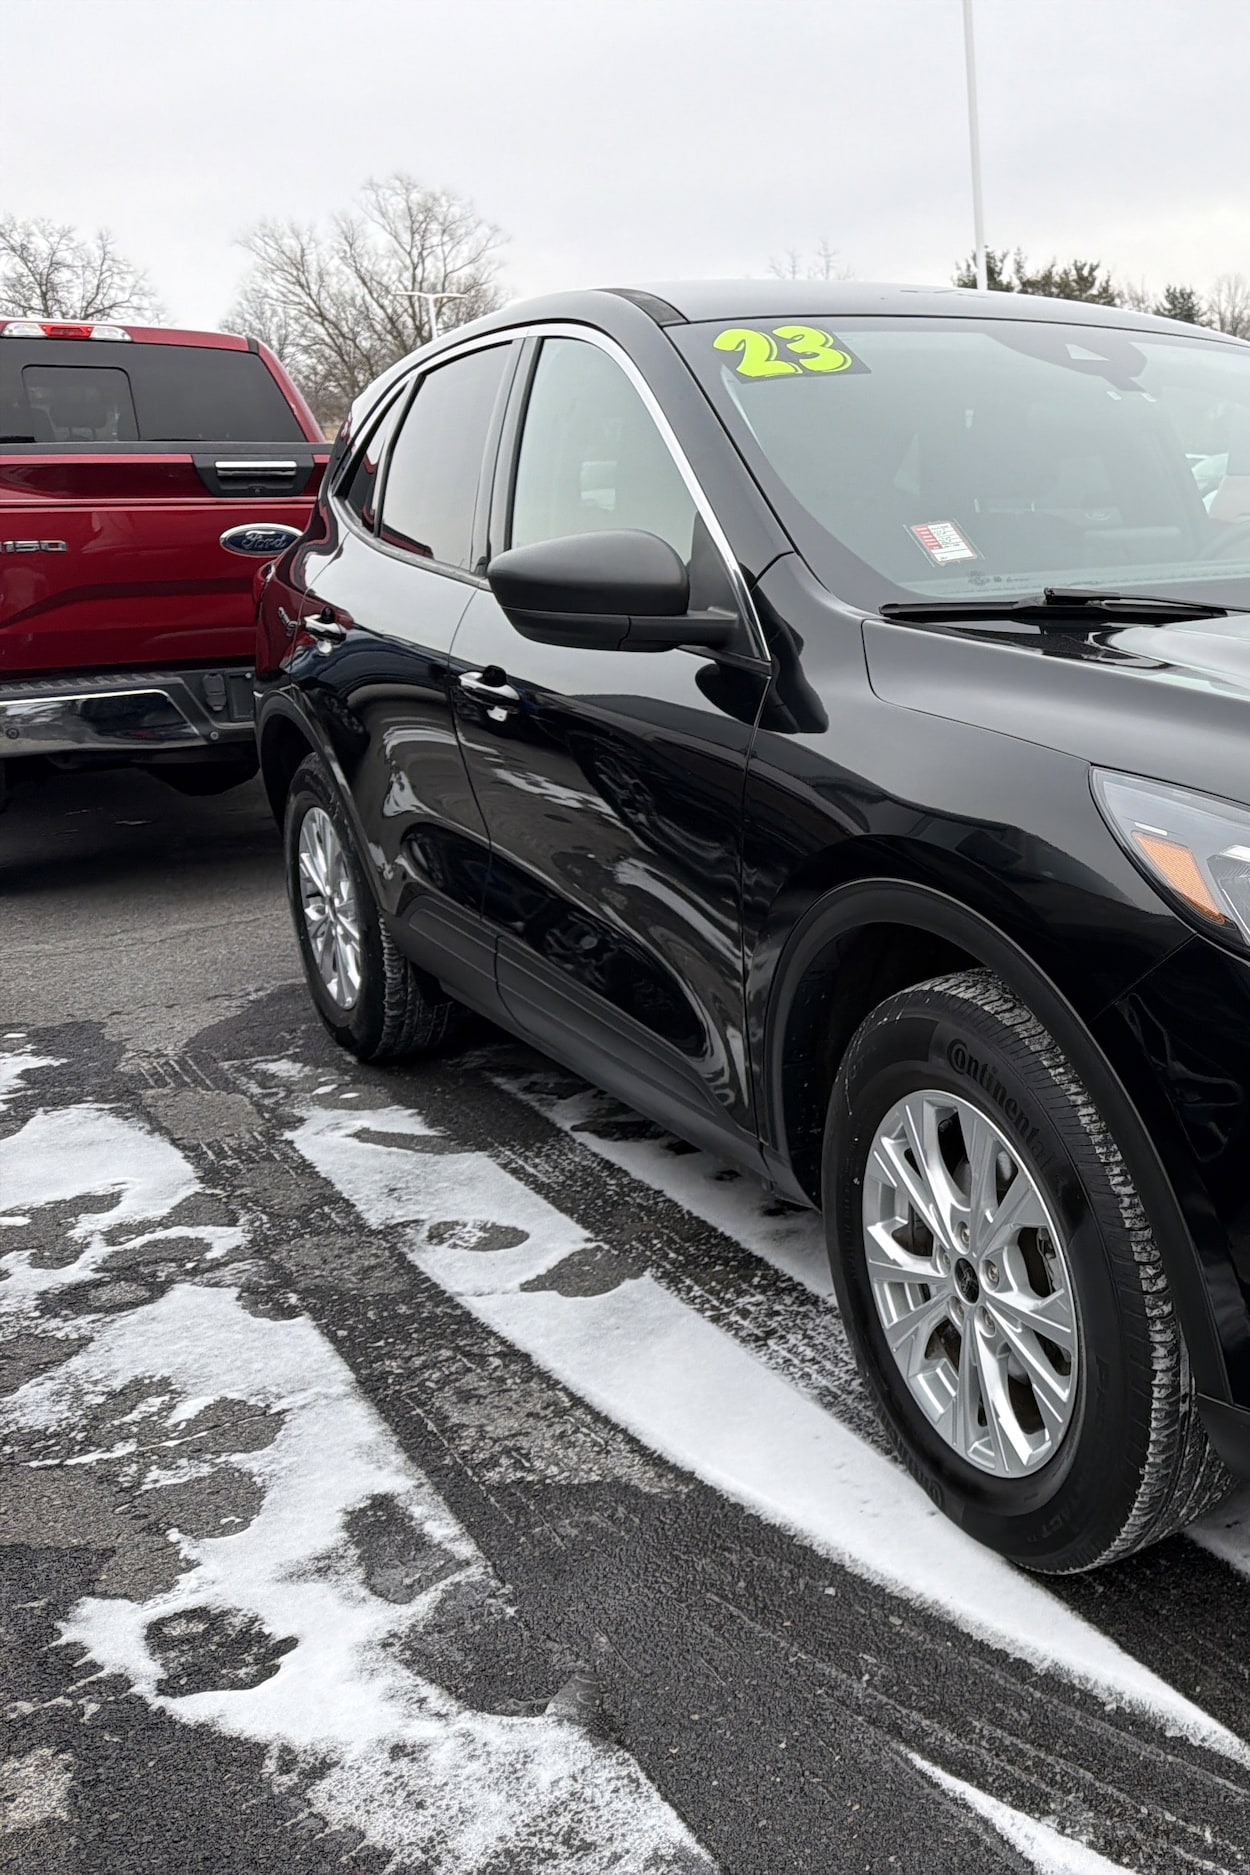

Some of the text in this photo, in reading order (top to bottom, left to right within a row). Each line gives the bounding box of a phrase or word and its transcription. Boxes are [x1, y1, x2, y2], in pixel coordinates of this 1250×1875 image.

[713, 325, 852, 377] 23
[0, 540, 68, 552] 150
[241, 530, 287, 549] Ford
[947, 1038, 1052, 1170] Continental
